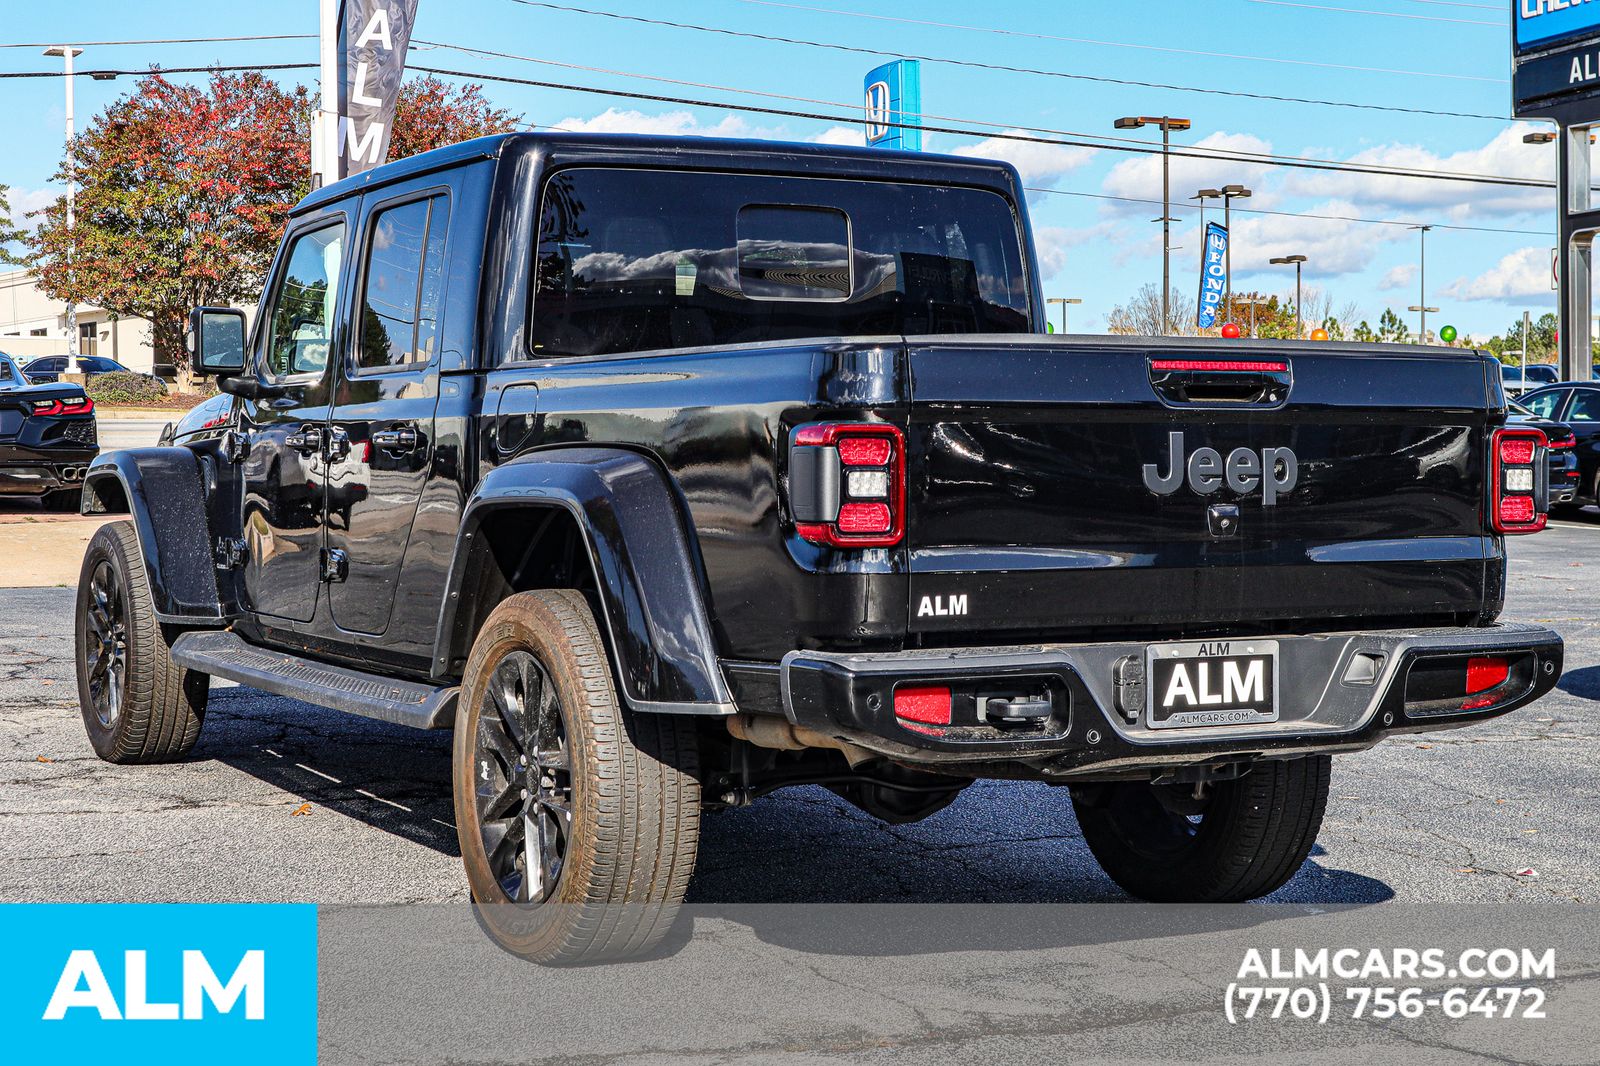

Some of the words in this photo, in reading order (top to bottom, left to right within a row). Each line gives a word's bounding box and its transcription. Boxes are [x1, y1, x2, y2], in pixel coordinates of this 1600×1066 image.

[338, 8, 393, 164] ALM
[1569, 51, 1600, 84] AL
[1202, 251, 1224, 317] HONDA
[1142, 431, 1298, 506] Jeep
[917, 594, 968, 617] ALM
[1198, 642, 1230, 656] ALM
[1162, 659, 1264, 707] ALM
